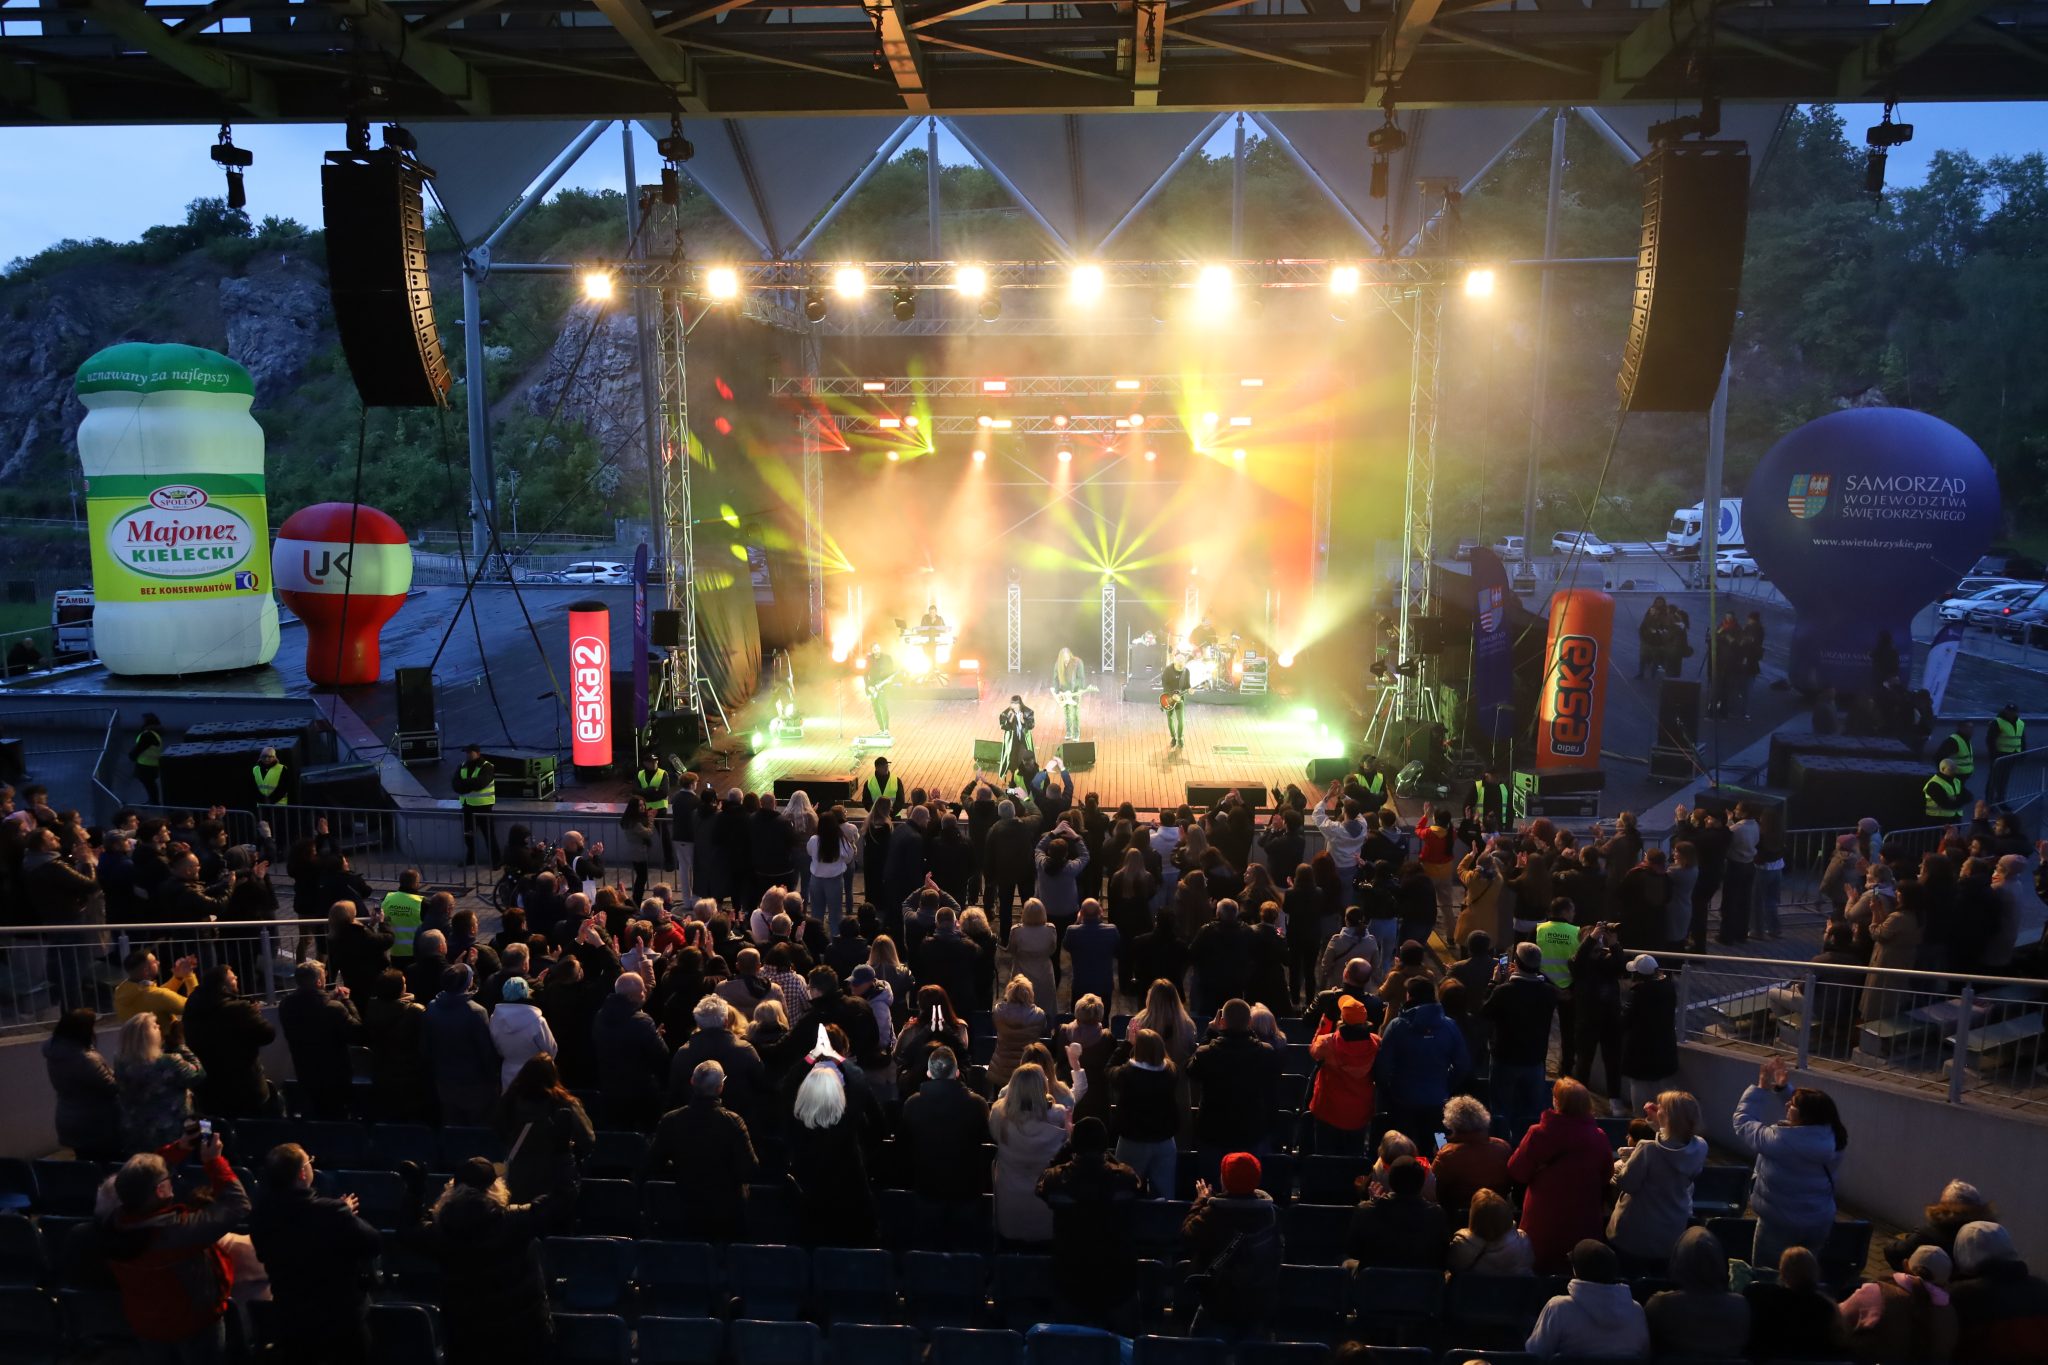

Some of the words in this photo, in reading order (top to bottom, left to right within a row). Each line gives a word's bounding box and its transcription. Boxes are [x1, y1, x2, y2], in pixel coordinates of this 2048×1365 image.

[150, 371, 168, 382] za
[172, 367, 230, 387] najlepszy
[1845, 475, 1966, 497] SAMORZĄD
[1843, 493, 1967, 508] WOJEWÓDZTWA
[1842, 505, 1966, 521] ŚWIĘTOKRZYSKIEGO
[127, 520, 237, 547] Majonez
[1812, 537, 1933, 550] www.swietokrzyskie.pro
[132, 546, 234, 562] KIELECKI
[140, 587, 156, 595] BEZ
[159, 582, 232, 594] KONSERWANTÓW
[1554, 638, 1594, 743] eska
